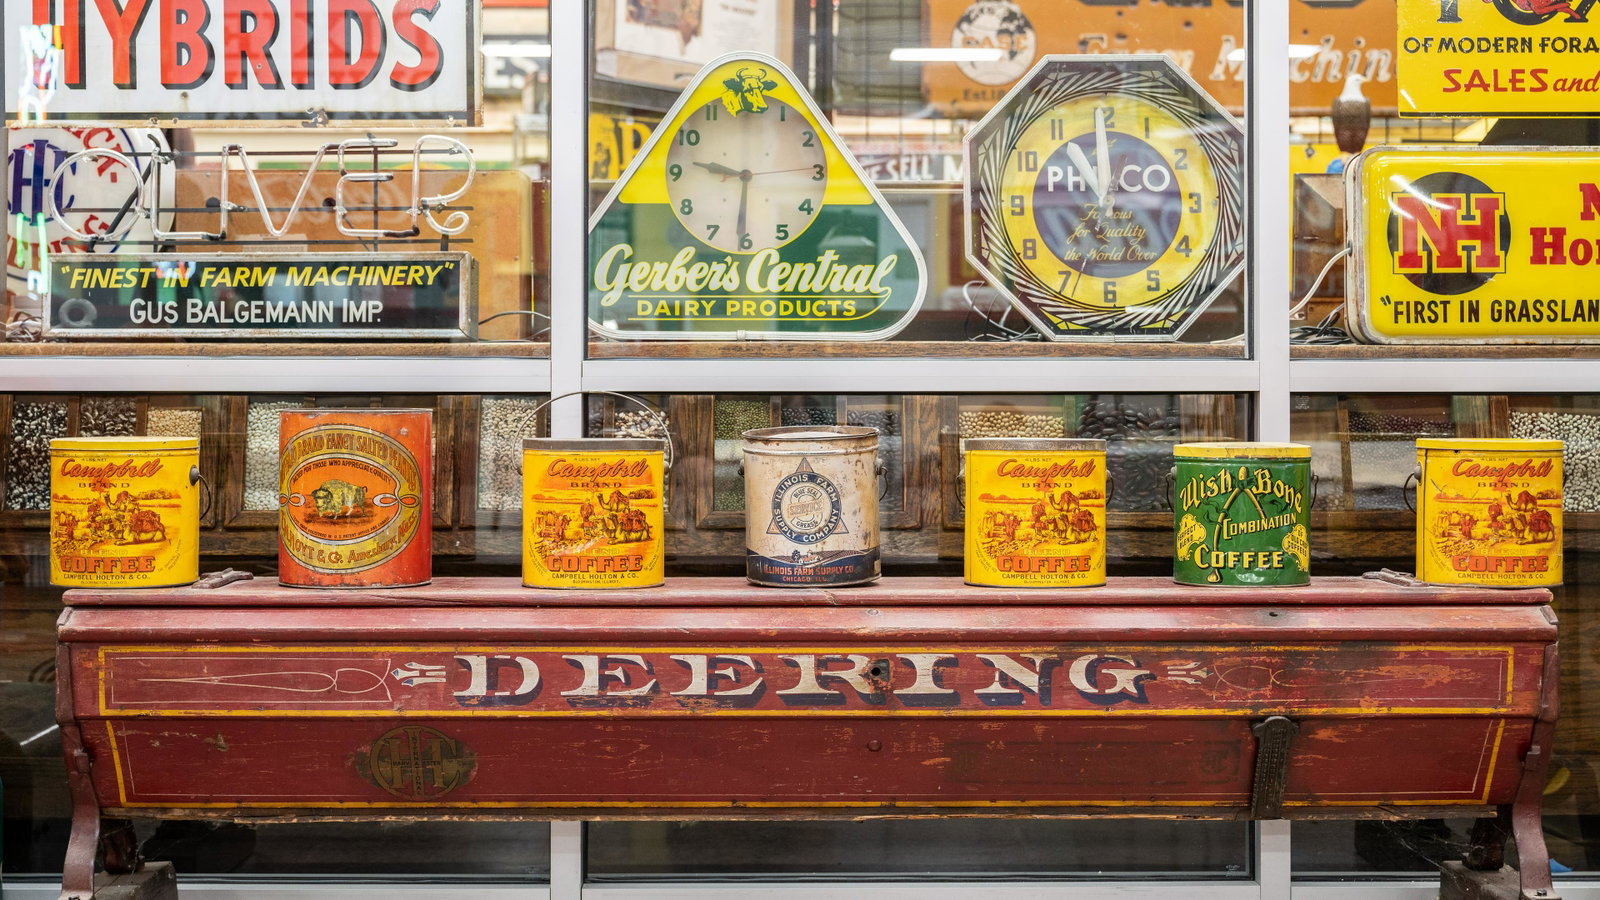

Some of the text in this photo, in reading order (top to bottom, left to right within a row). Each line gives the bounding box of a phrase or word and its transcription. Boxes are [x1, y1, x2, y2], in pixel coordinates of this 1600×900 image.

[31, 0, 445, 92] HYBRIDS
[1403, 37, 1434, 54] OF
[1437, 37, 1533, 54] MODERN
[1442, 68, 1600, 92] SALES and
[678, 129, 700, 147] 10
[802, 131, 815, 148] 2
[1017, 151, 1038, 172] 10
[1174, 149, 1188, 170] 2
[669, 164, 682, 182] 9
[812, 164, 826, 182] 3
[1046, 164, 1171, 193] PHCO
[48, 134, 476, 242] OLIVER
[680, 198, 694, 216] 8
[798, 198, 814, 216] 4
[1010, 195, 1024, 216] 9
[1188, 192, 1202, 214] 3
[706, 224, 720, 240] 7
[739, 233, 753, 250] 6
[776, 224, 790, 241] 5
[1066, 222, 1146, 246] for Quality
[1392, 192, 1507, 274] NH
[1022, 238, 1037, 260] 8
[1064, 244, 1158, 260] the World Over
[1174, 236, 1192, 258] 4
[61, 262, 454, 288] "FINEST IN FARM MACHINERY"
[594, 243, 898, 306] Gerber's Central
[1058, 270, 1072, 294] 7
[1146, 270, 1160, 292] 5
[1104, 282, 1117, 304] 6
[130, 298, 178, 324] GUS
[186, 298, 336, 324] BALGEMANN
[636, 300, 857, 316] DAIRY PRODUCTS
[1380, 294, 1450, 324] "FIRST
[1460, 300, 1480, 323] IN
[326, 433, 355, 450] FANCY
[356, 436, 388, 460] SALTED
[61, 458, 164, 481] Campbell
[312, 460, 327, 470] THOSE
[548, 458, 649, 482] Campbell
[996, 458, 1097, 483] Campbell
[1452, 458, 1554, 482] Campbell
[774, 474, 840, 503] ILLINOIS FARM
[1180, 468, 1302, 514] Wish Bone
[774, 508, 840, 542] SUPPLY COMPANY
[1222, 512, 1297, 540] COMBINATION
[60, 556, 156, 574] COFFEE
[317, 550, 326, 564] &
[548, 555, 643, 573] COFFEE
[998, 556, 1091, 573] COFFEE
[1194, 544, 1284, 568] COFFEE
[1452, 556, 1549, 573] COFFEE
[763, 564, 792, 575] ILLINOIS
[794, 566, 814, 576] FARM
[816, 566, 844, 575] SUPPLY
[453, 653, 1155, 707] DEERING
